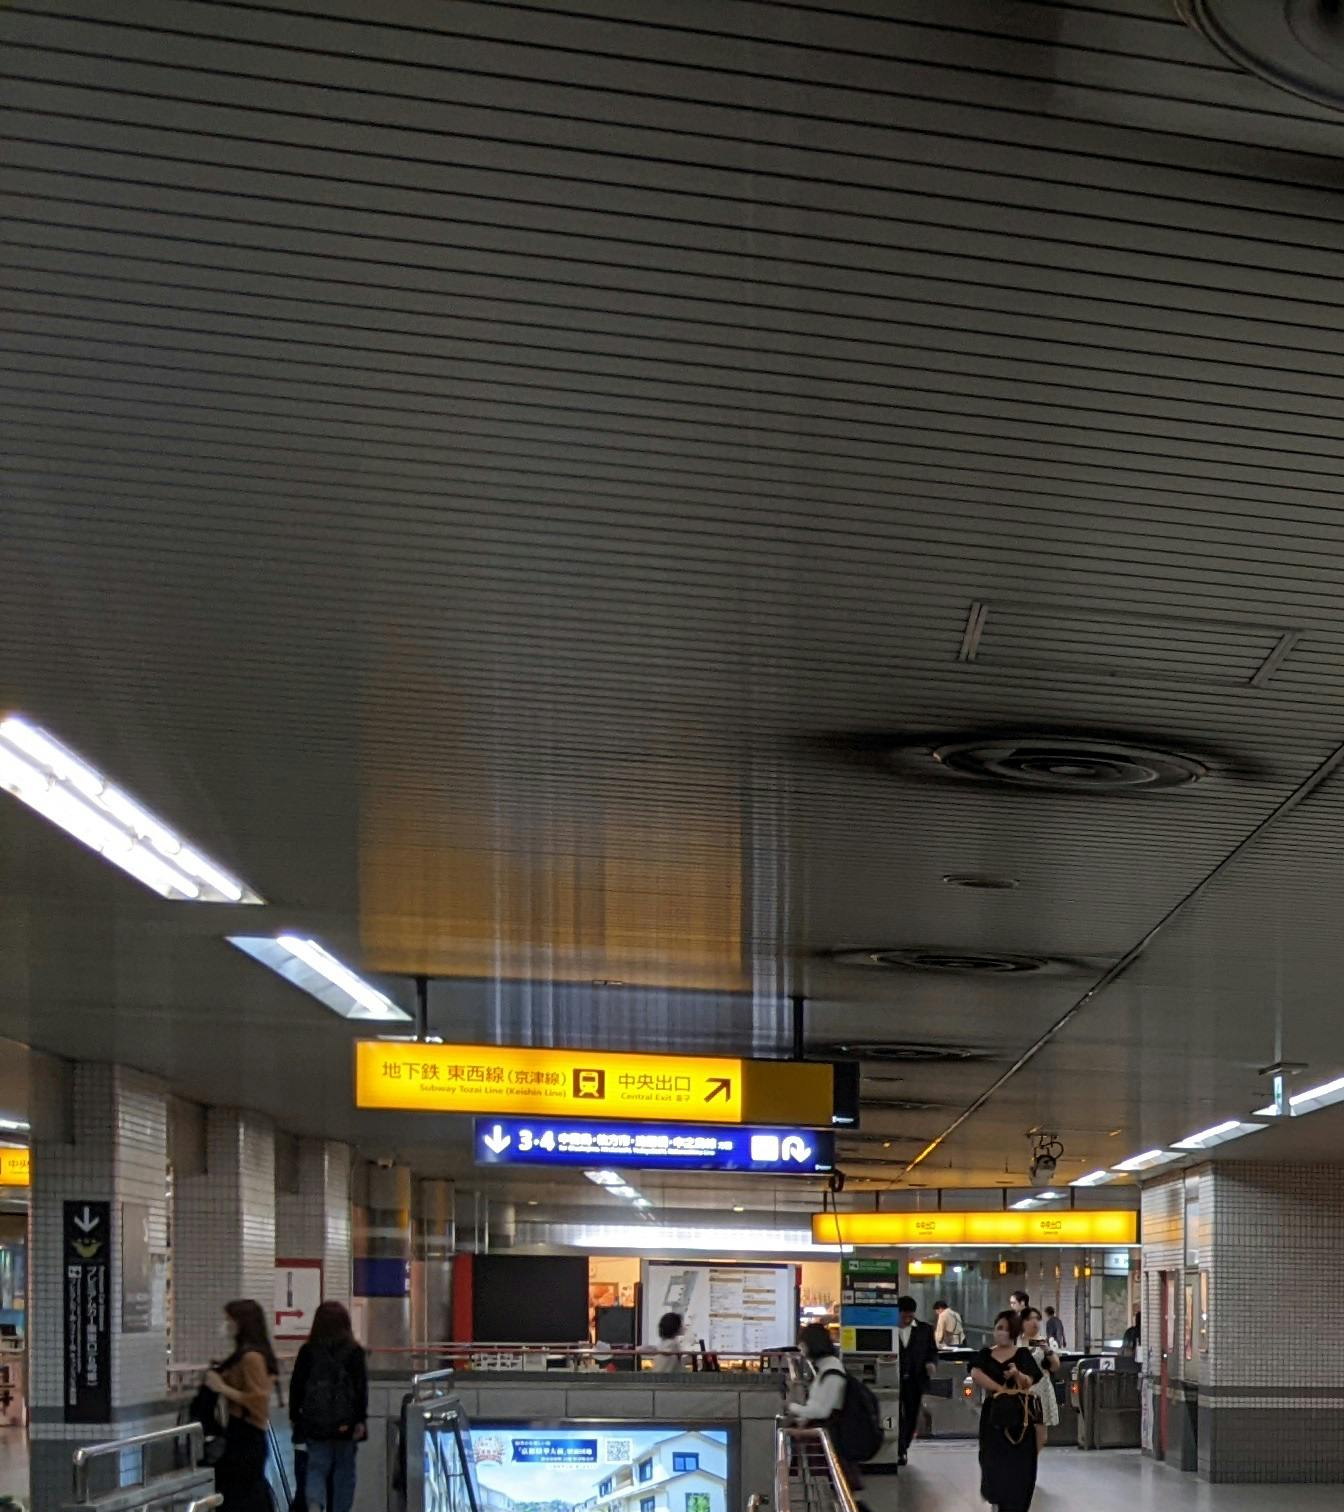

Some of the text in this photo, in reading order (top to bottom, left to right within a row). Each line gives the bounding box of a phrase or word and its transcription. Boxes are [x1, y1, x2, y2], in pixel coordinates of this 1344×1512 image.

[382, 1061, 440, 1080] 地下鉄
[618, 1072, 691, 1092] 中央出口
[420, 1084, 567, 1098] Subway Tozai Line (Keishin Line)
[620, 1091, 652, 1101] Central
[655, 1093, 672, 1102] Exit
[1104, 1360, 1111, 1370] 2
[886, 1417, 892, 1429] 1
